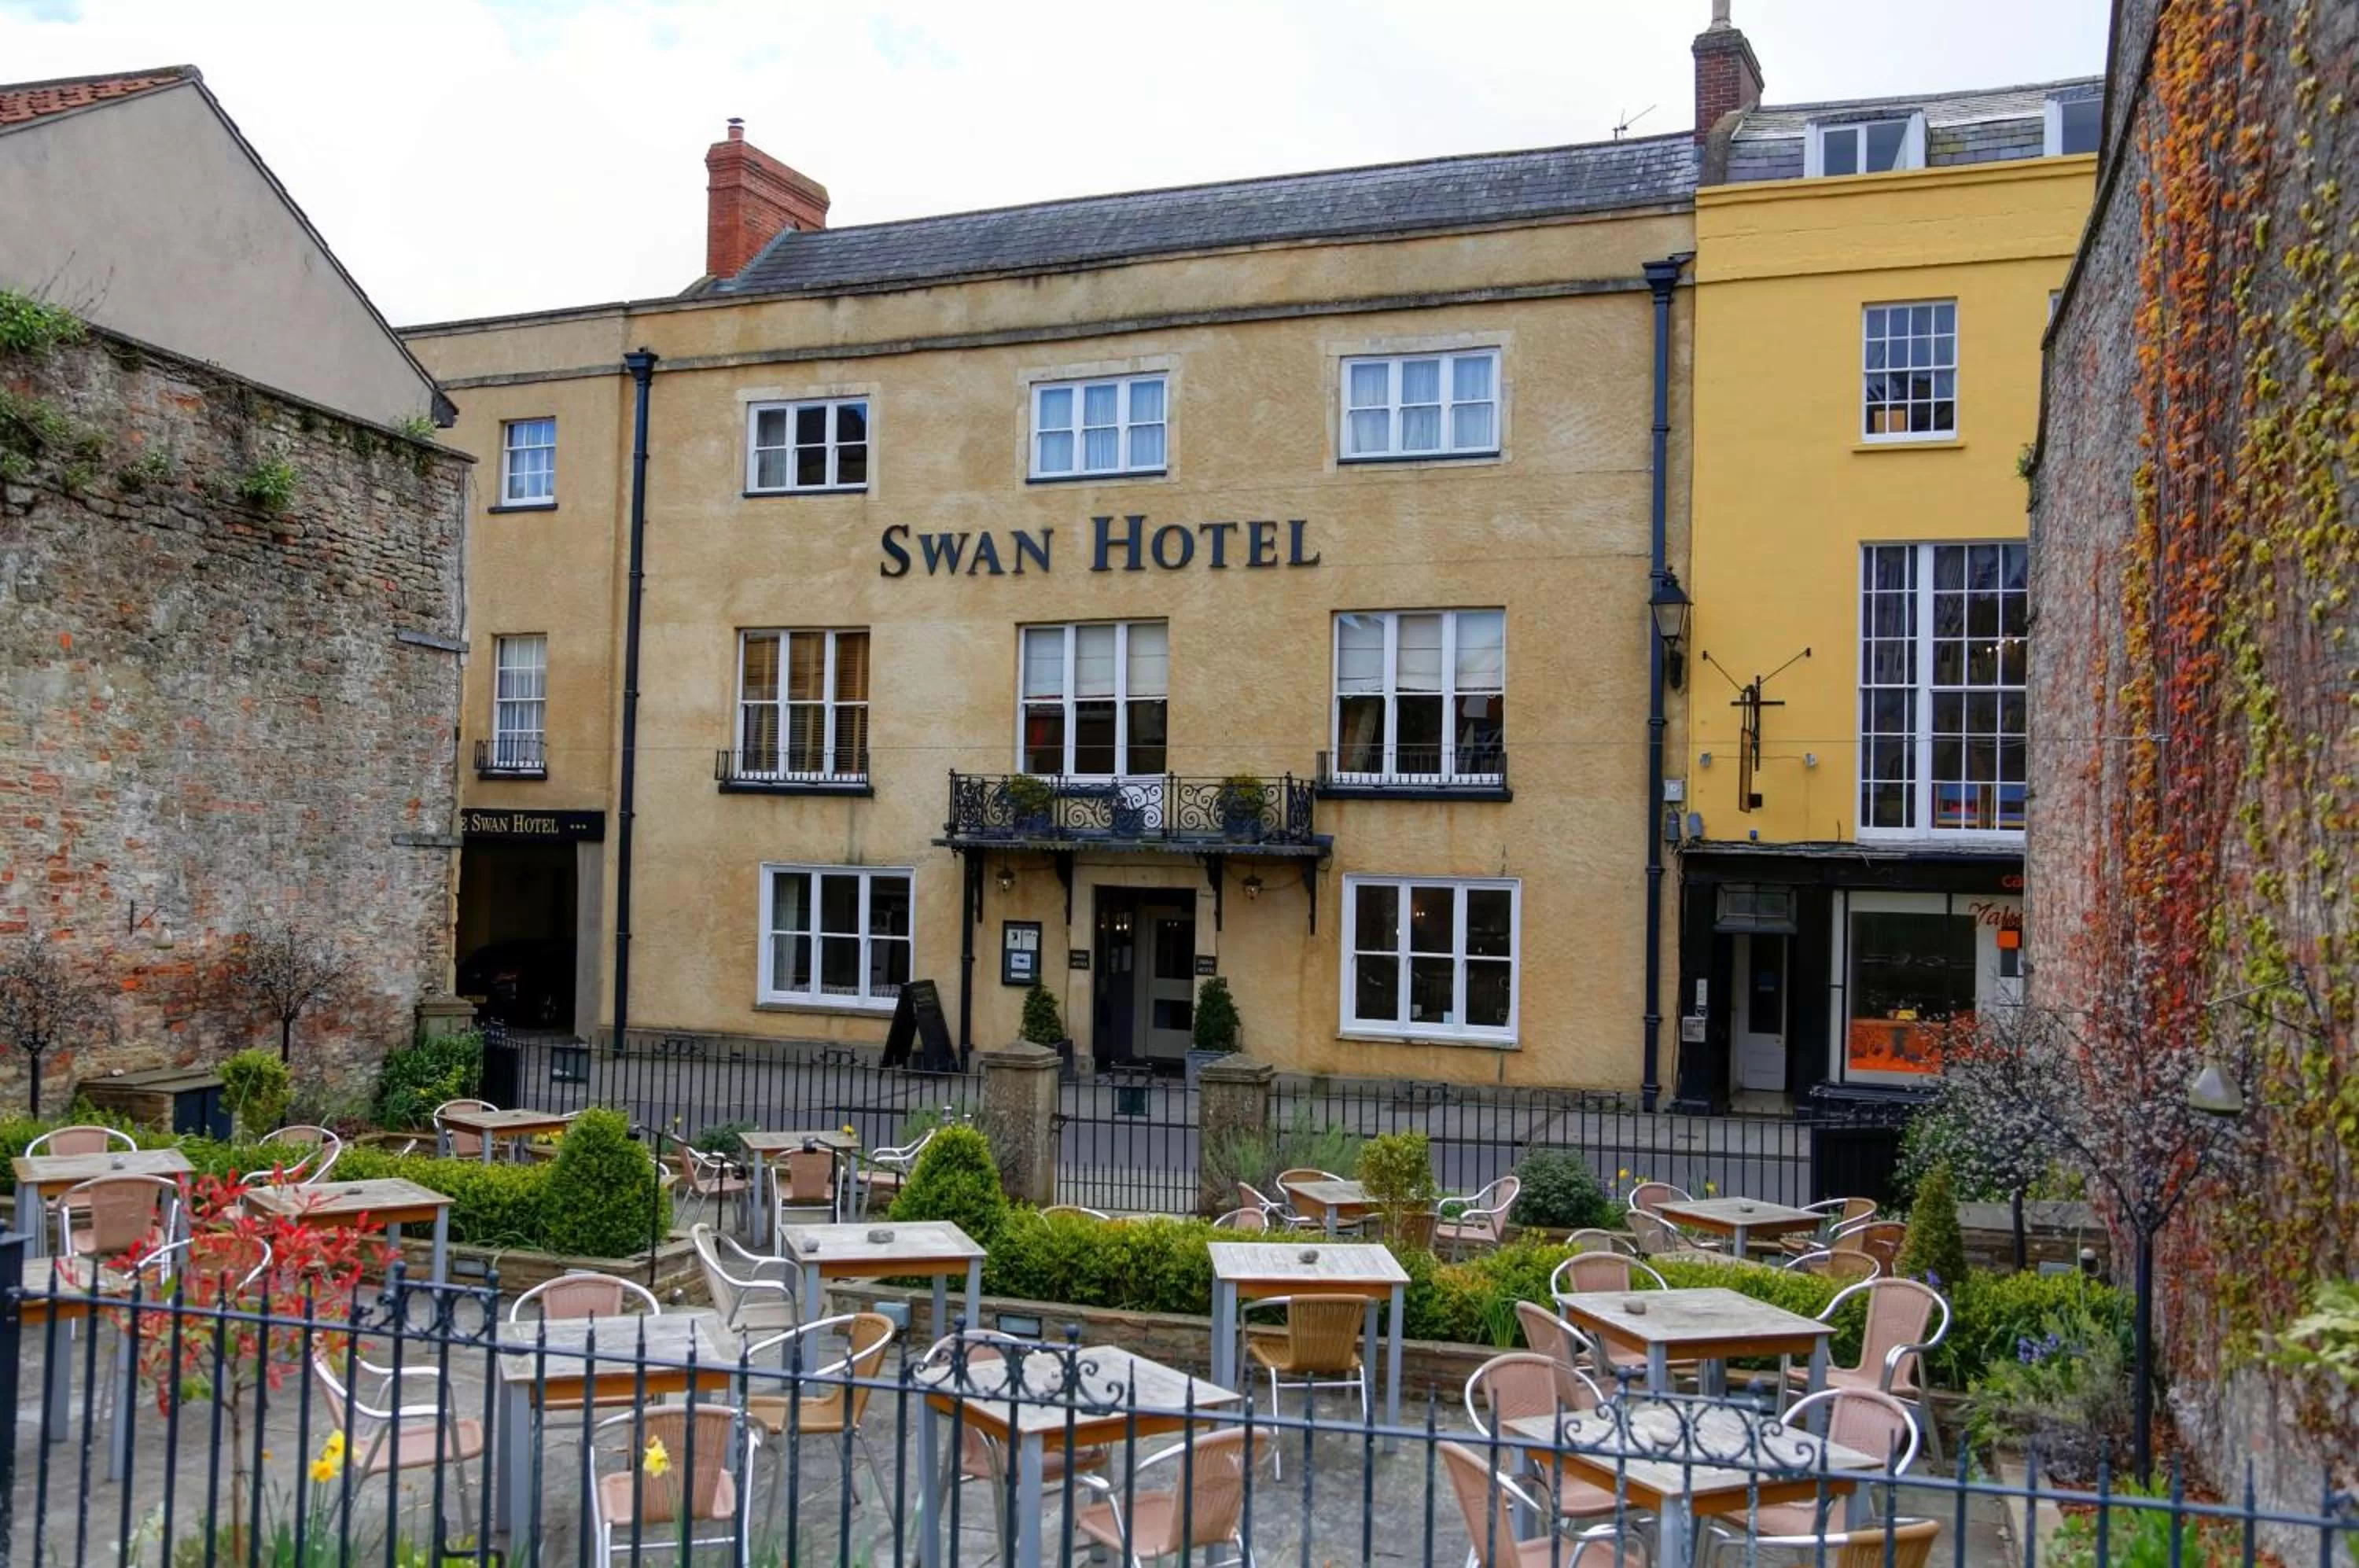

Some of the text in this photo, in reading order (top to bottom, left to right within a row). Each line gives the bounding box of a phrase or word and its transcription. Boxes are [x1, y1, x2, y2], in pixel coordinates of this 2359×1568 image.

[880, 515, 1321, 578] SWAN HOTEL
[471, 814, 509, 833] SWAN
[513, 814, 559, 834] HOTEL
